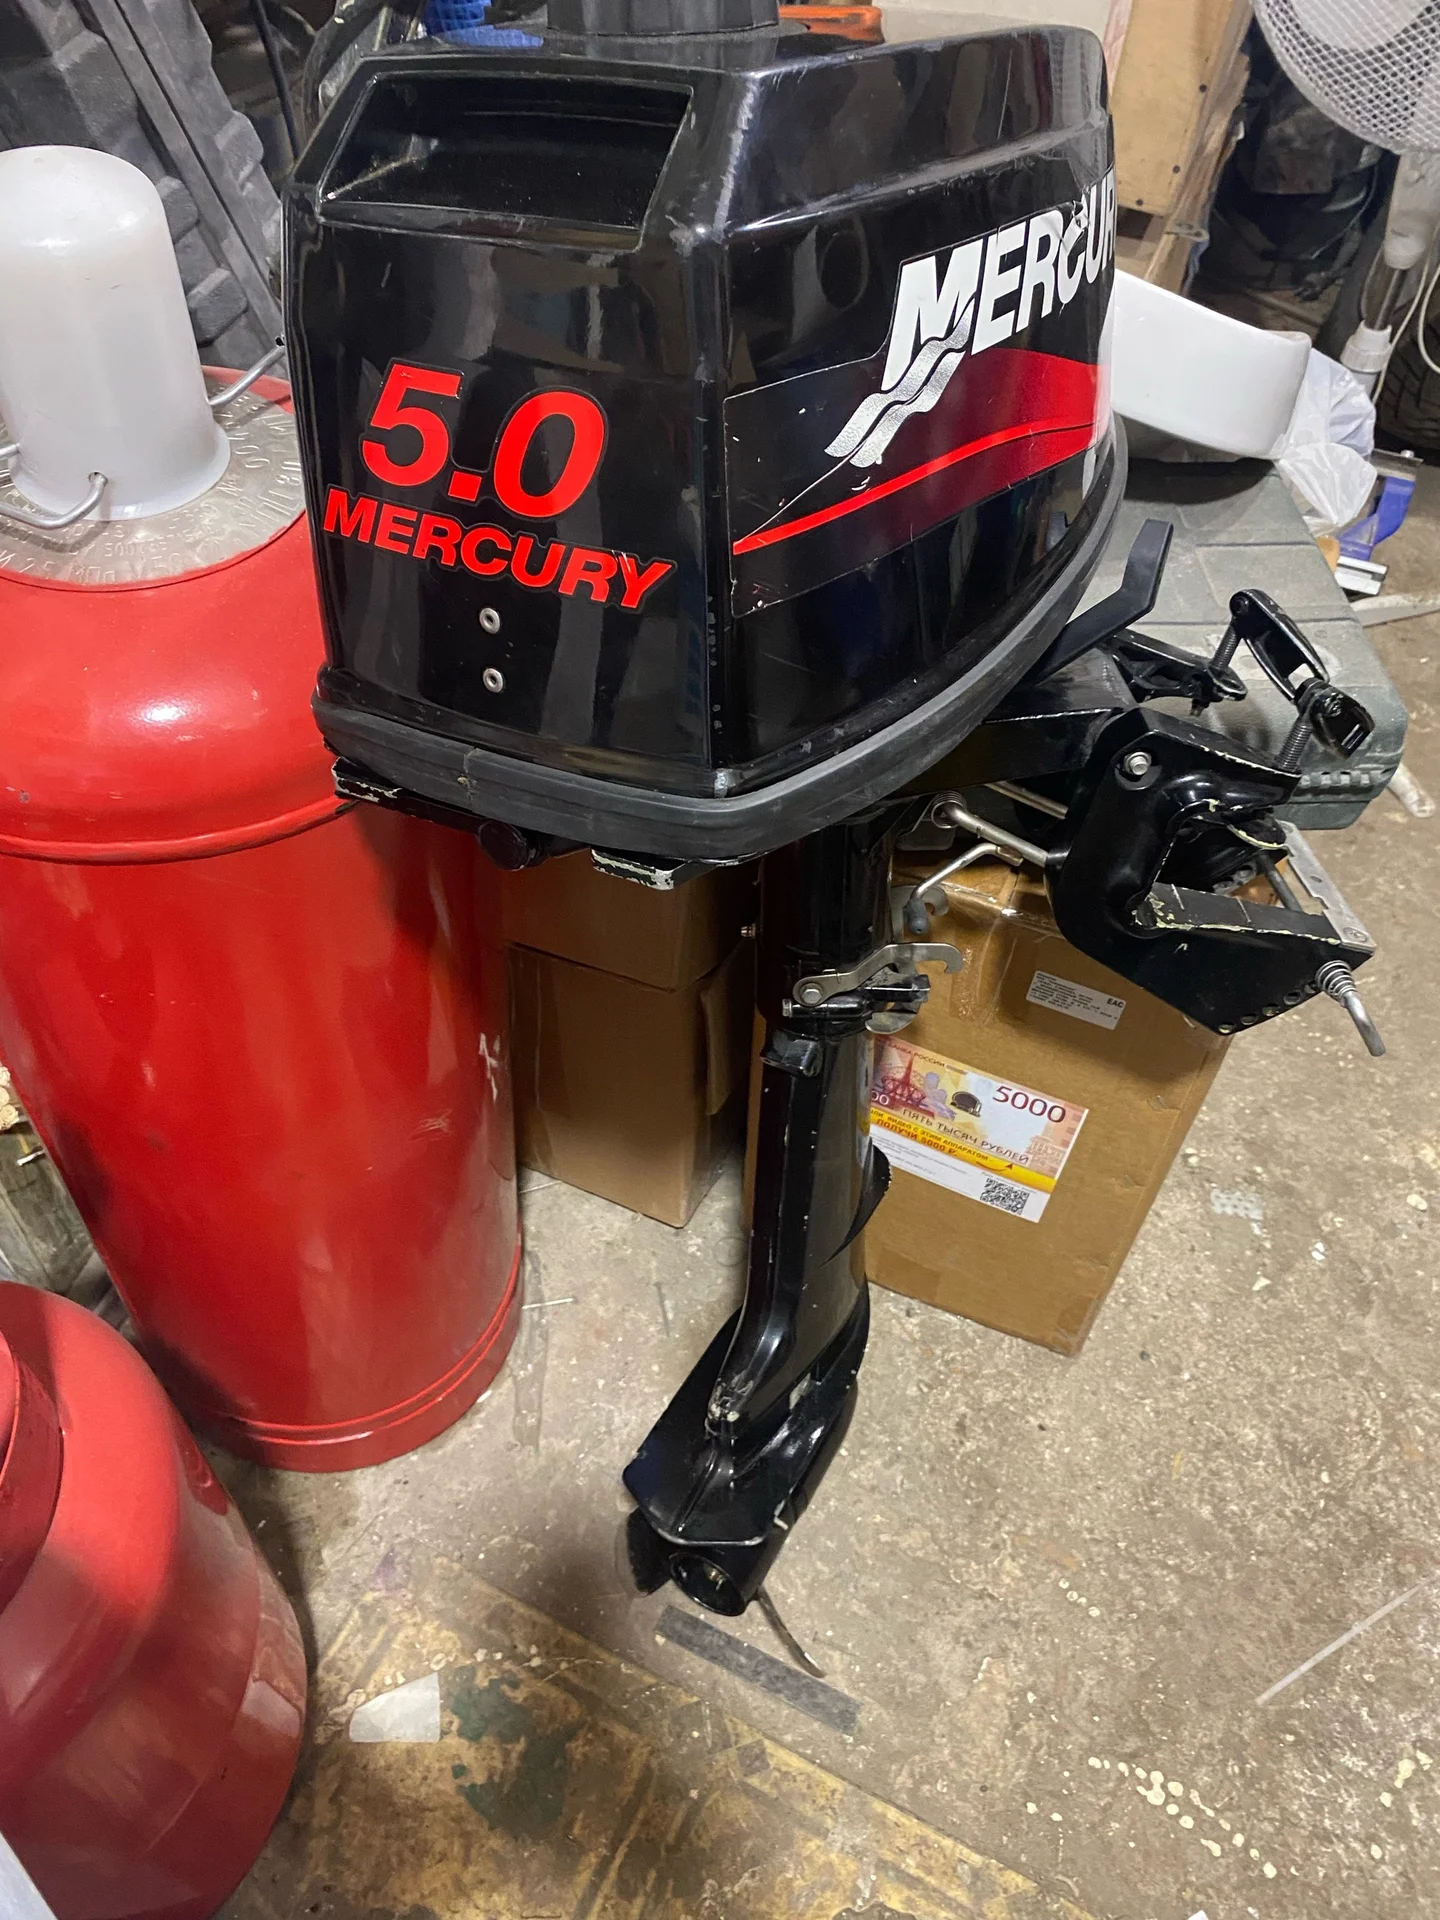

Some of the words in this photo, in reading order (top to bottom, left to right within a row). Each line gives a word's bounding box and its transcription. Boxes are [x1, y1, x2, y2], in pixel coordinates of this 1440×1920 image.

[361, 363, 606, 518] 5.0
[323, 488, 673, 609] MERCURY
[1106, 997, 1125, 1009] EAC
[914, 1052, 945, 1067] РОССИИ
[992, 1085, 1067, 1123] 5000
[876, 1118, 918, 1140] ПОЛУЧИ
[920, 1136, 946, 1152] 5000
[887, 1116, 912, 1130] ВИДЕО
[920, 1129, 942, 1142] ЭТИМ
[943, 1138, 990, 1161] АППАРАТОМ
[902, 1108, 933, 1127] ПЯТЬ
[937, 1121, 979, 1145] ТЫСЯЧ
[980, 1138, 1030, 1164] РУБЛЕЙ
